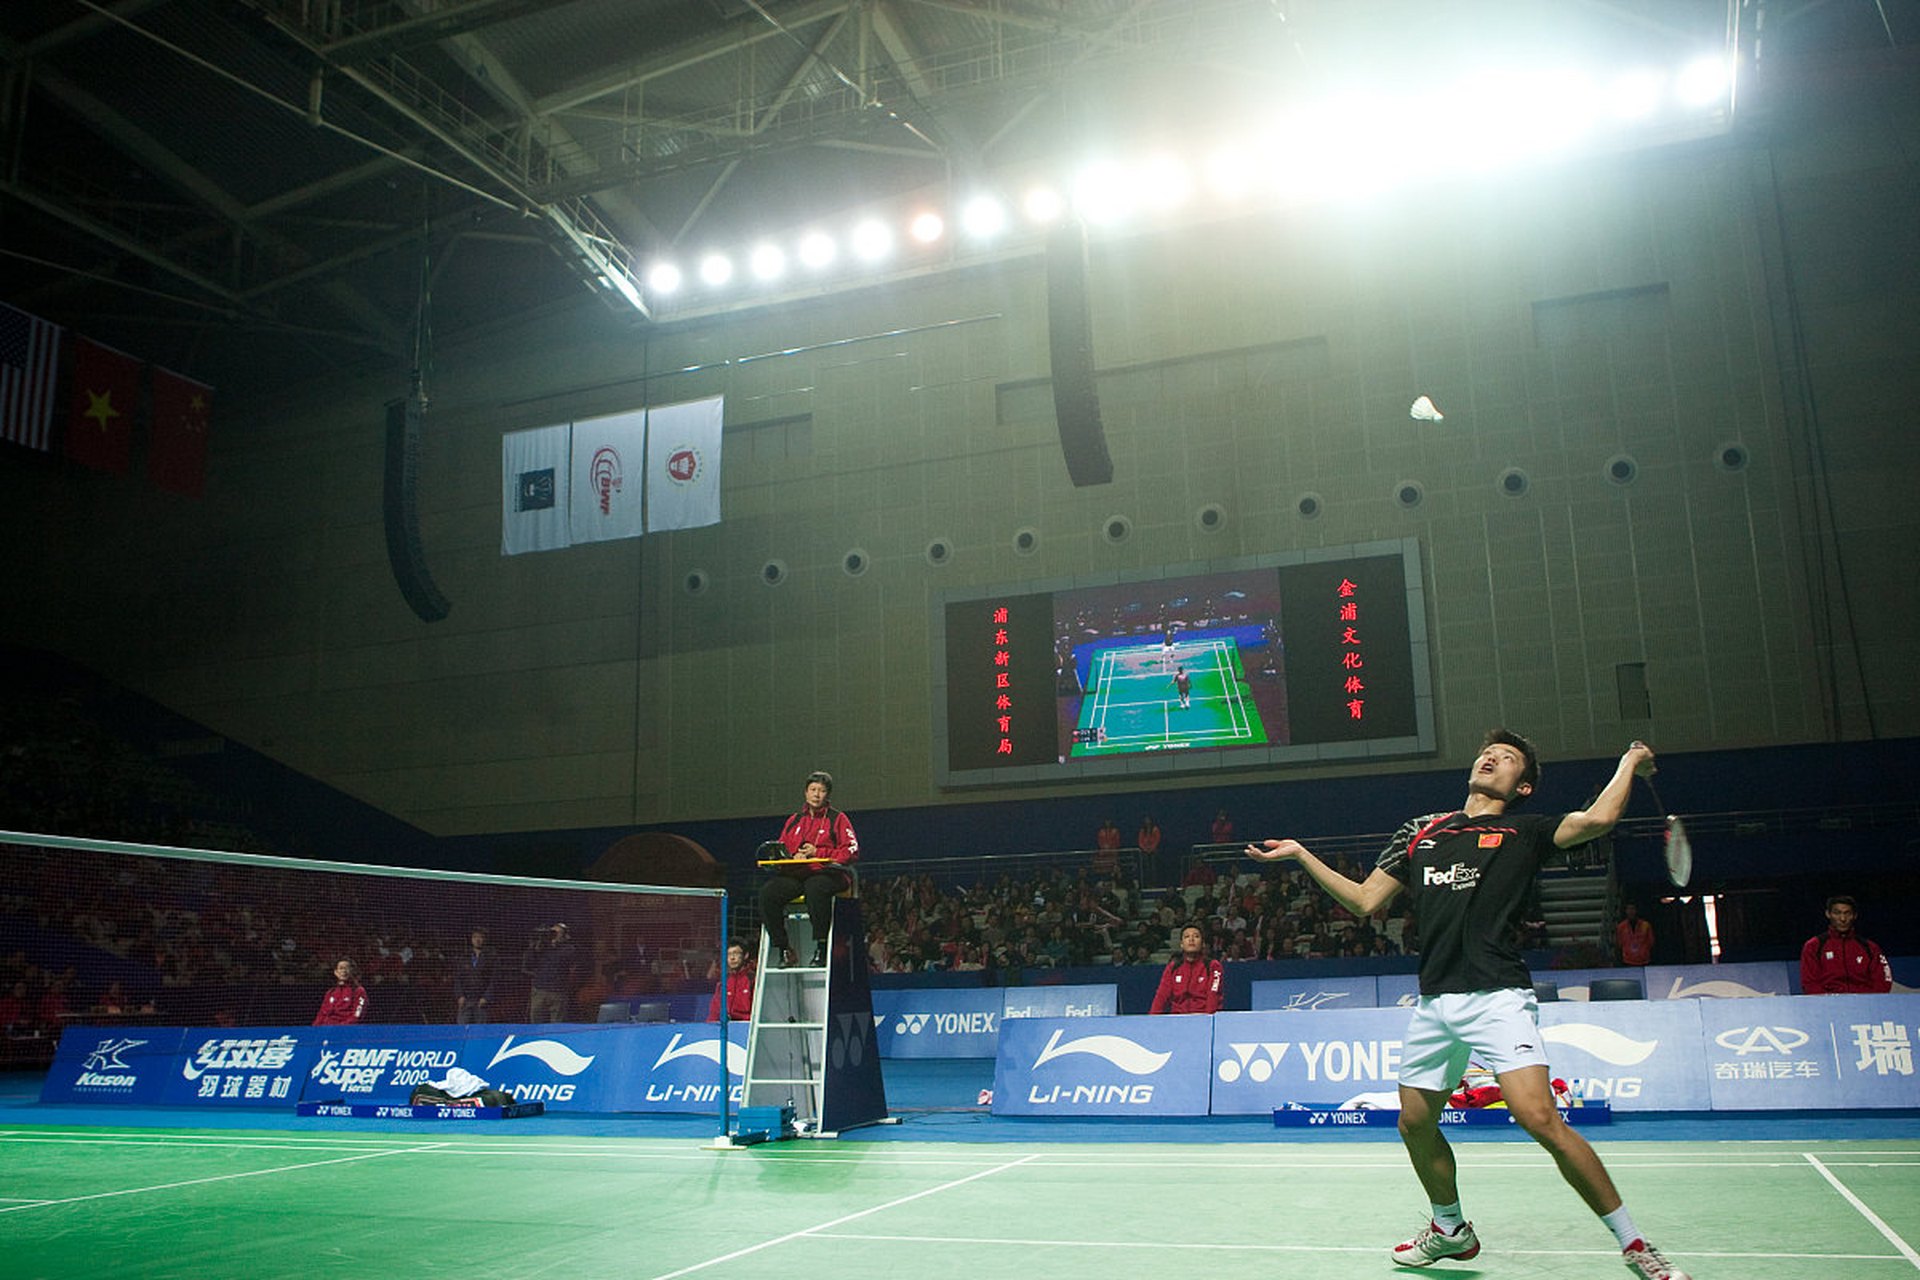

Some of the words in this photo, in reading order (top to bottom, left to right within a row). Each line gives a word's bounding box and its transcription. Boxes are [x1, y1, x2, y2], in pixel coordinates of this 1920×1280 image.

[1337, 578, 1365, 720] 金浦文化体育
[993, 607, 1013, 755] 浦东新区体育局
[933, 1012, 997, 1034] YONEX
[195, 1035, 298, 1069] 红双喜
[341, 1049, 398, 1067] BWF
[395, 1051, 457, 1068] WORLD
[1299, 1041, 1404, 1082] YONE
[75, 1072, 137, 1087] Kason
[319, 1060, 385, 1092] Super
[1714, 1060, 1821, 1080] 奇瑞汽车
[198, 1074, 293, 1099] 羽球器材
[1028, 1085, 1155, 1104] LI-NING
[1330, 1112, 1367, 1124] YONEX
